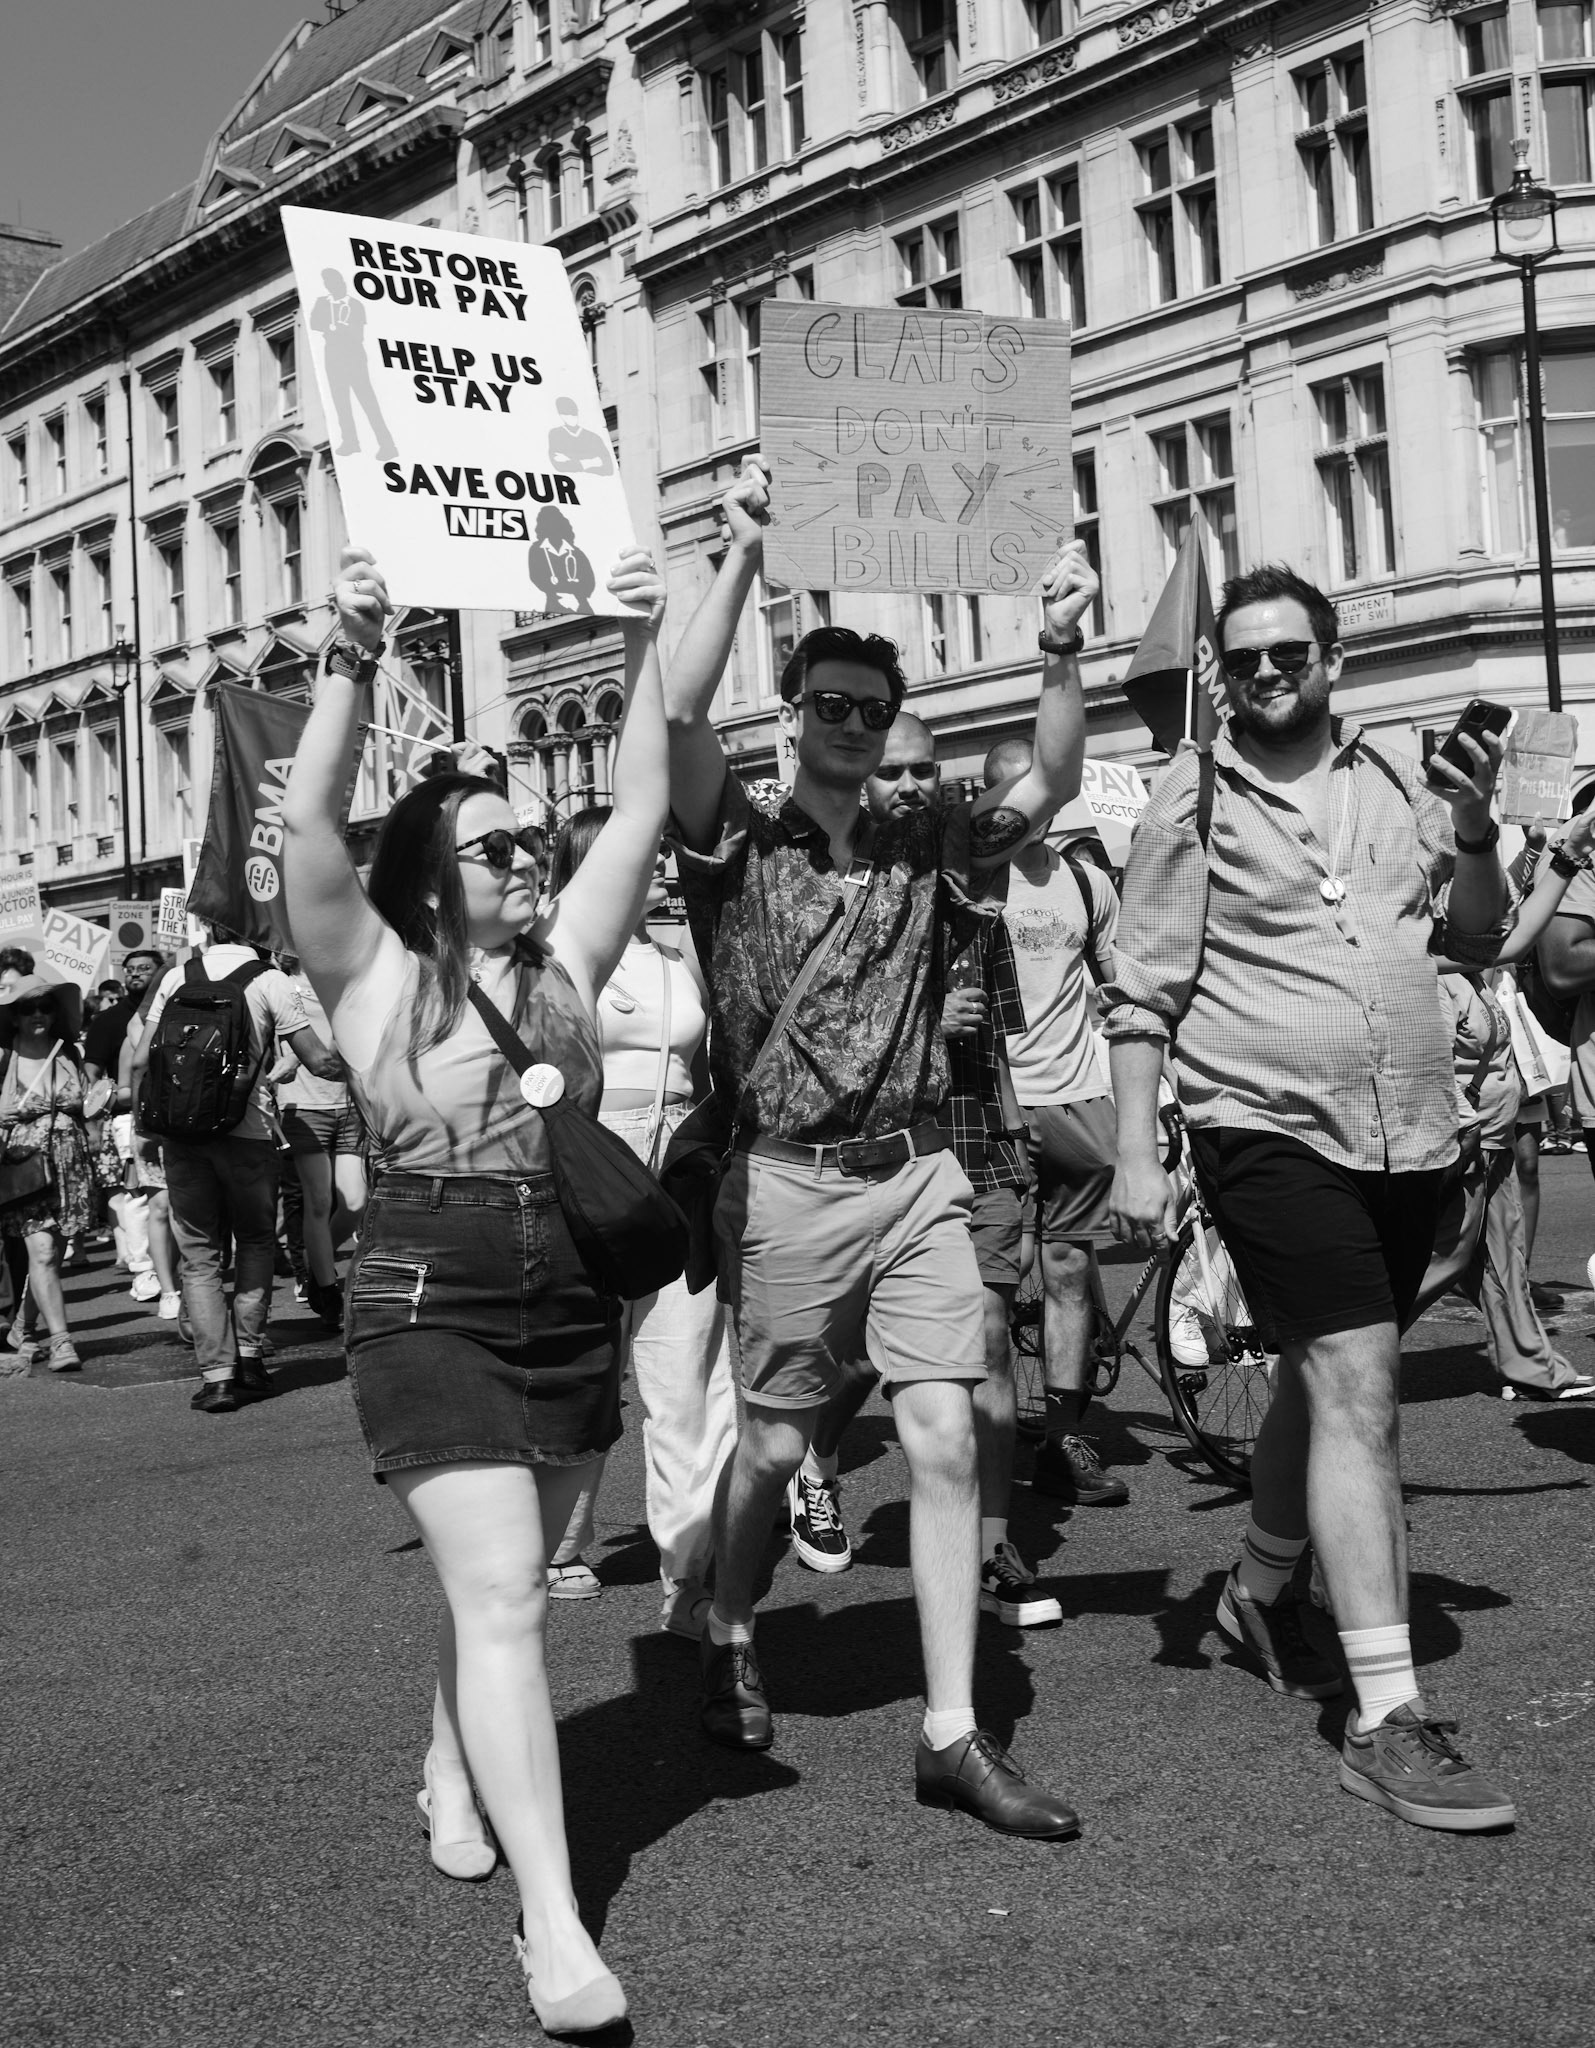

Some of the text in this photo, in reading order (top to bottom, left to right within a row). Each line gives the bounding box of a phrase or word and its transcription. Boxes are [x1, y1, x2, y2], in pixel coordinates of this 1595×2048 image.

[349, 237, 523, 290] RESTORE
[353, 271, 528, 321] OUR PAY
[378, 338, 542, 385] HELP US
[805, 312, 1025, 394] CLAPS
[413, 374, 512, 413] STAY
[836, 404, 1014, 455] DON'T
[383, 462, 580, 505] SAVE OUR
[857, 462, 1000, 525] PAY
[449, 507, 525, 539] NHS
[833, 525, 1029, 592] BILLS
[1336, 597, 1388, 615] RLIAMENT
[1368, 609, 1389, 621] SW1
[1082, 764, 1137, 798] PAY
[250, 757, 296, 856] BMA
[17, 913, 34, 924] PAY
[163, 895, 186, 908] STRI
[163, 907, 175, 920] TO
[668, 907, 687, 915] Toile
[1020, 908, 1052, 916] TOKYO
[45, 913, 106, 954] PAY
[161, 919, 179, 934] THE
[46, 949, 94, 975] OCTORS
[534, 1075, 547, 1094] NOW
